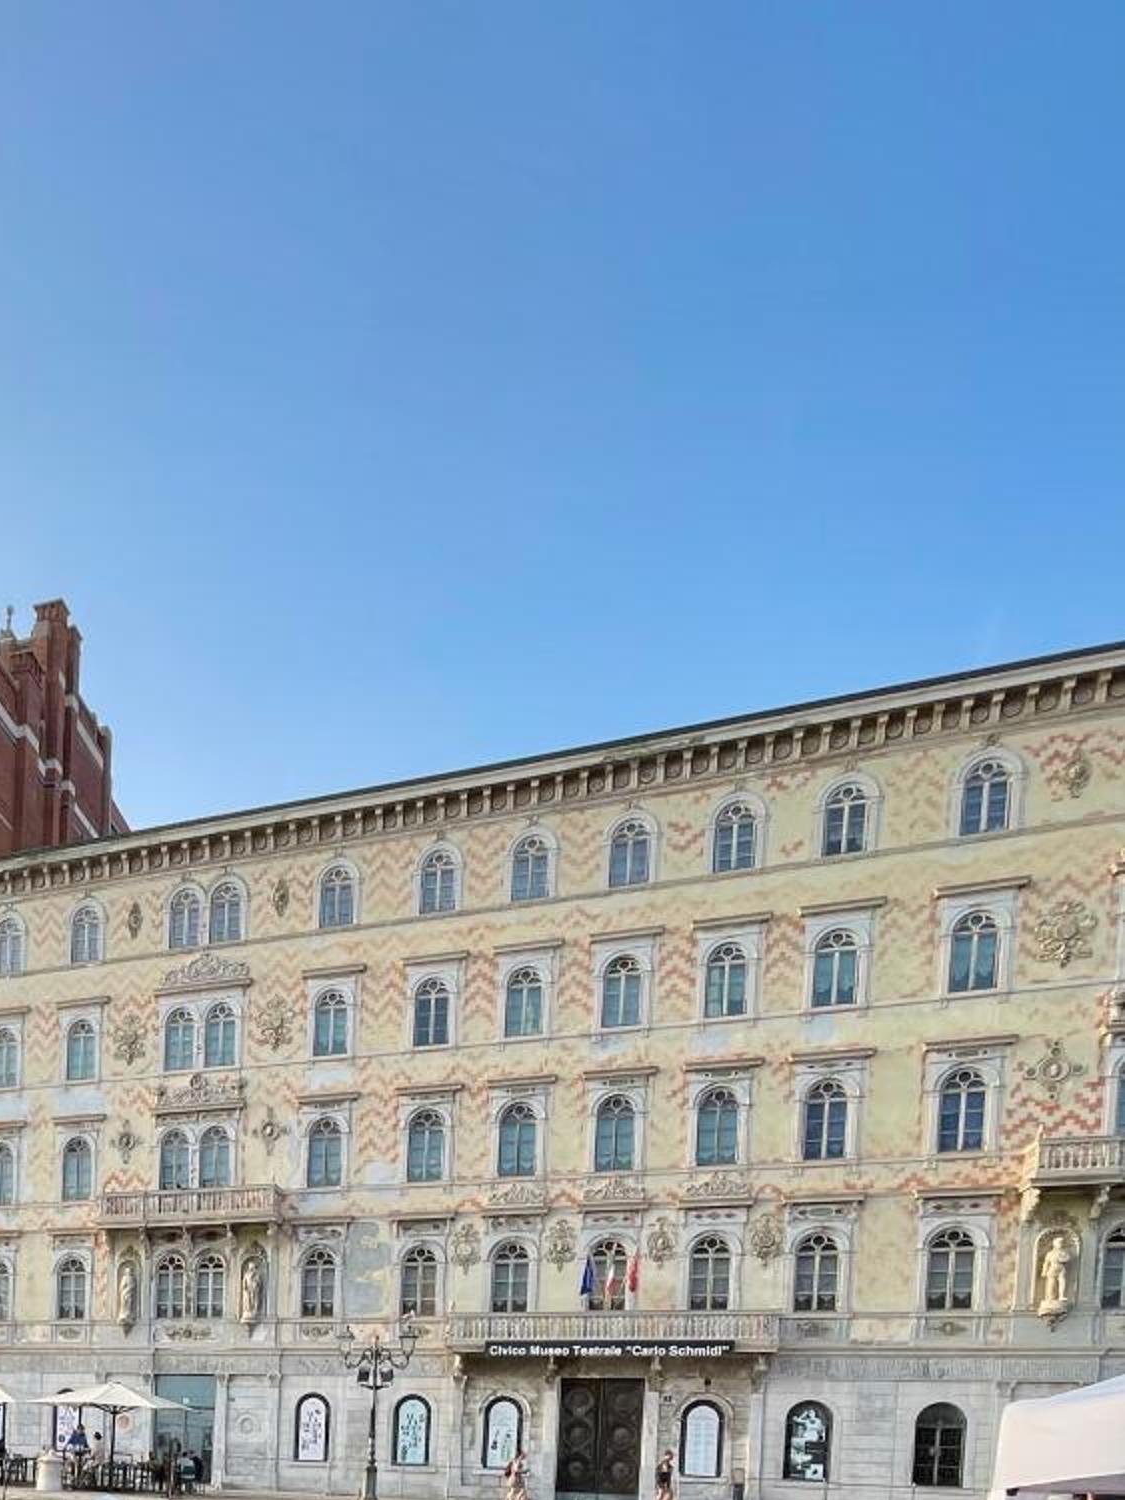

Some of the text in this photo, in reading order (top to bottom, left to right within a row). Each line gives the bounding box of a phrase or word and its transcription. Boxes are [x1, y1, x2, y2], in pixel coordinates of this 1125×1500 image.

[488, 1345, 527, 1356] Civico
[530, 1345, 570, 1356] Museo
[572, 1345, 623, 1356] Teatrale
